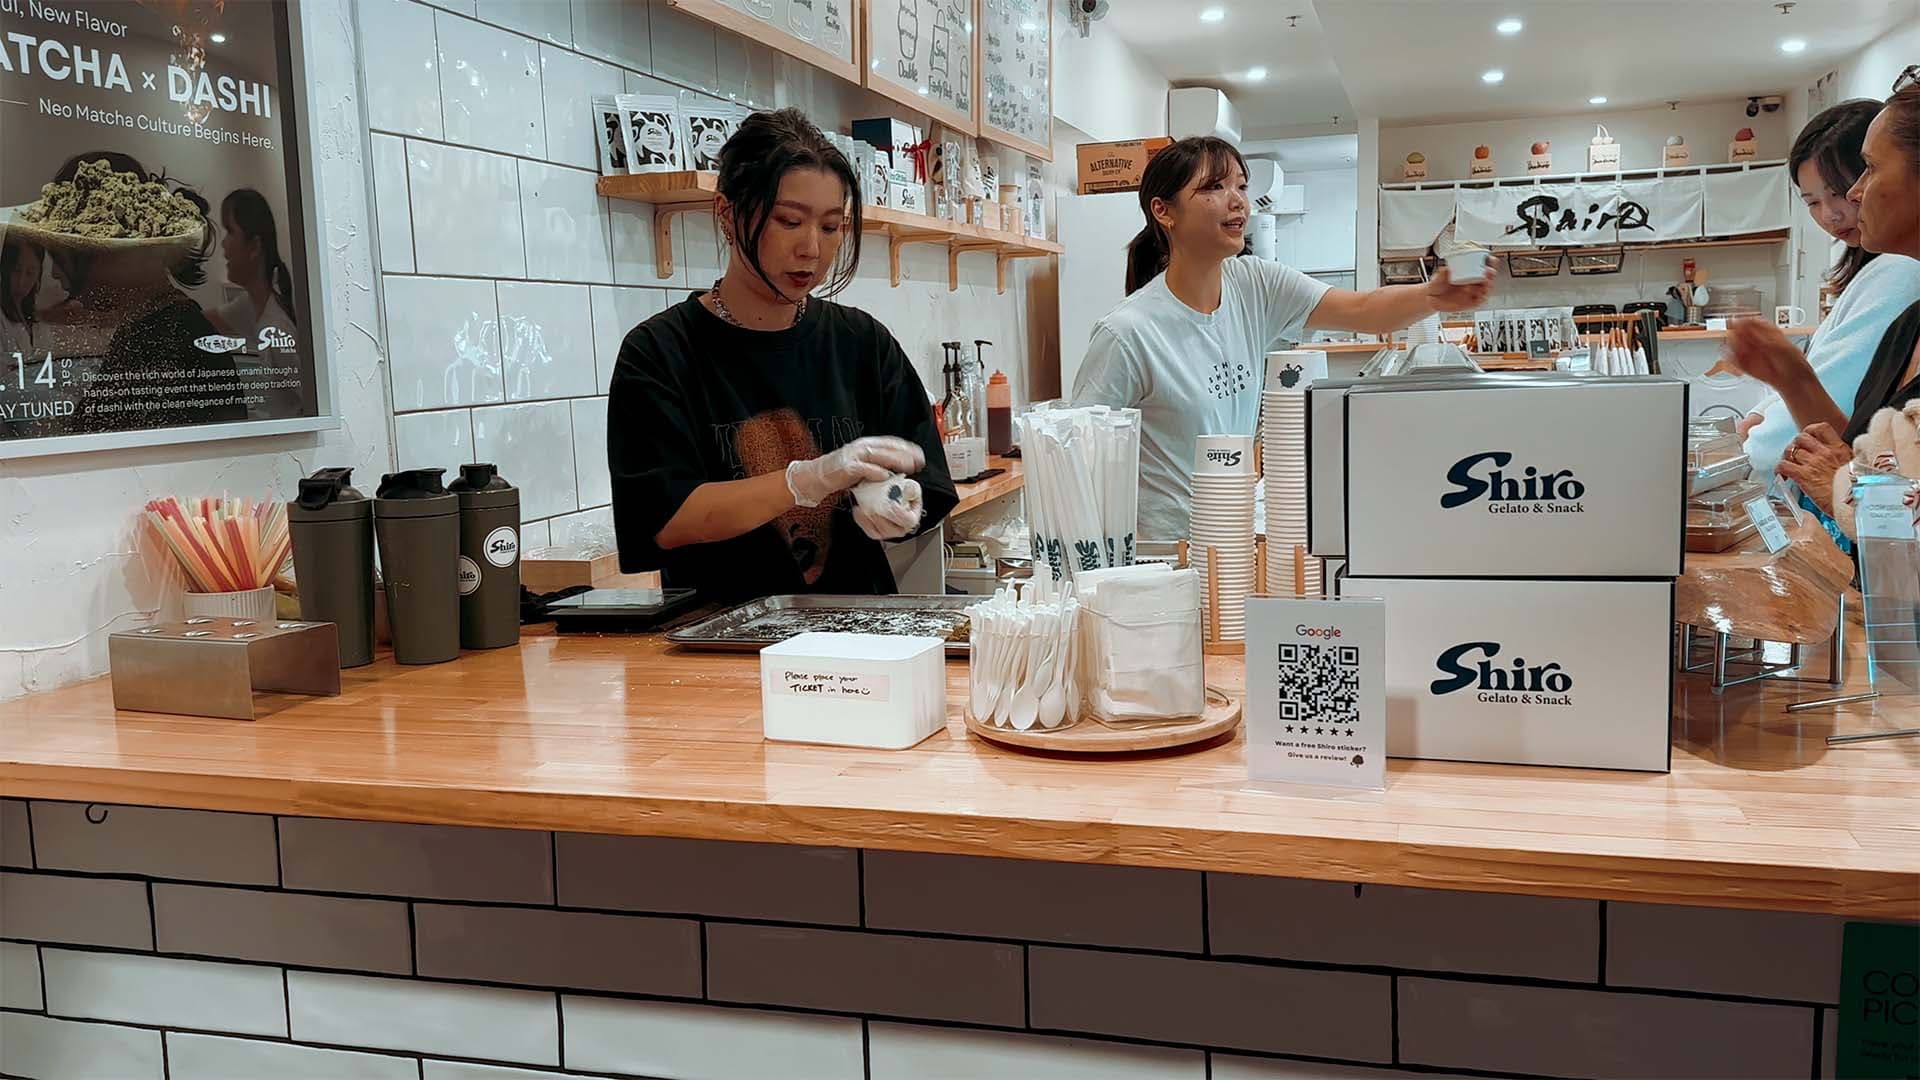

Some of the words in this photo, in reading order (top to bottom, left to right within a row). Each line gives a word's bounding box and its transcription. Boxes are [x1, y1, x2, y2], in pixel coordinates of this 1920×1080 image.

[29, 0, 71, 25] New
[75, 10, 128, 37] Flavor
[168, 65, 271, 118] DASHI
[40, 98, 72, 118] Neo
[76, 103, 134, 128] Matcha
[137, 115, 192, 136] Culture
[194, 123, 240, 144] Begins
[242, 132, 274, 149] Here.
[1089, 158, 1133, 172] ALTERNATIVE
[258, 327, 296, 350] Shiro
[61, 358, 72, 387] Sat
[81, 371, 125, 382] Discover
[125, 370, 140, 380] the
[142, 371, 160, 380] rich
[161, 369, 185, 379] world
[187, 368, 196, 378] of
[197, 368, 235, 378] Japanese
[236, 367, 263, 376] umami
[263, 366, 293, 376] through
[83, 387, 130, 398] hands-on
[131, 385, 163, 397] tasting
[164, 384, 188, 394] event
[189, 383, 207, 393] that
[208, 382, 236, 392] blends
[236, 381, 250, 390] the
[250, 382, 270, 391] deep
[270, 379, 301, 389] tradition
[20, 401, 74, 418] TUNED
[85, 403, 96, 413] of
[97, 402, 123, 413] dashi
[124, 400, 144, 411] with
[145, 400, 161, 410] the
[162, 400, 185, 409] clean
[186, 398, 224, 409] elegance
[225, 396, 234, 405] of
[1207, 451, 1242, 467] Shiro
[1441, 452, 1585, 509] Shiro
[1488, 503, 1529, 513] Gelato
[1532, 503, 1543, 513] &
[1546, 502, 1585, 513] Snack
[490, 540, 516, 554] Shiro
[1296, 624, 1342, 640] Google
[1430, 642, 1573, 695] Shiro
[784, 671, 809, 681] Please
[838, 675, 858, 684] your
[790, 684, 824, 693] TICKET
[841, 686, 860, 694] here
[1477, 692, 1518, 704] Gelato
[1521, 694, 1532, 704] &
[1535, 694, 1573, 706] Snack
[1275, 740, 1294, 748] Want
[1337, 744, 1367, 752] sticker?
